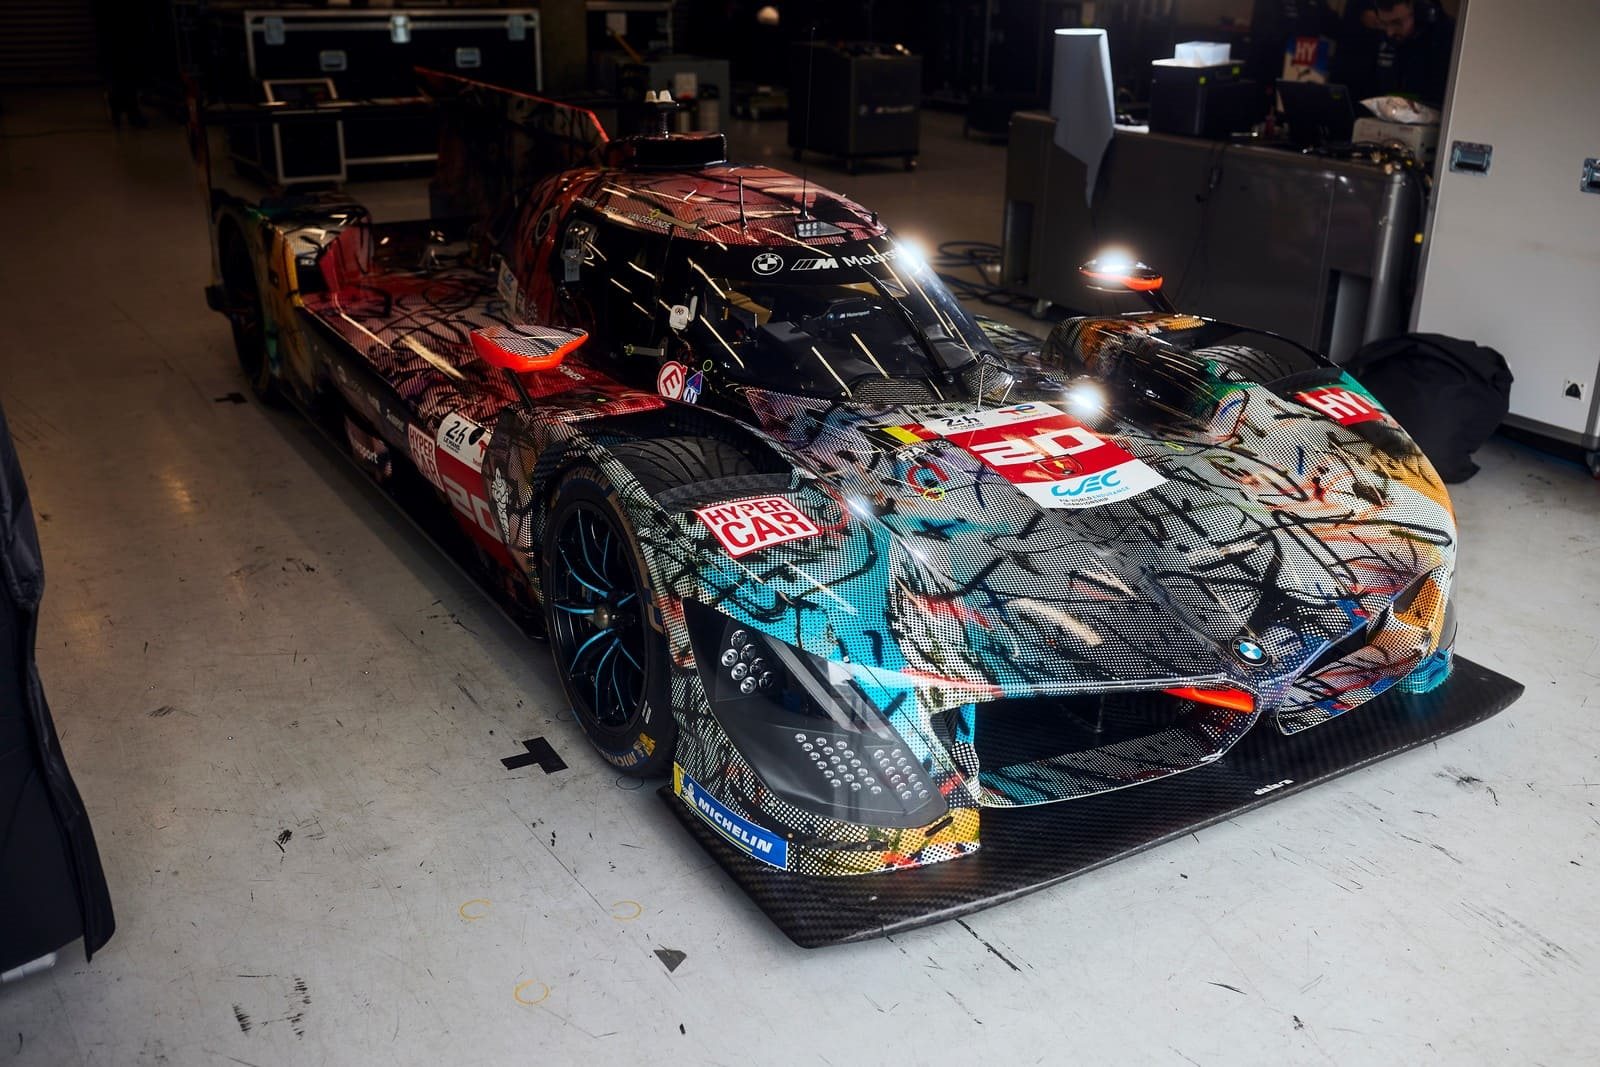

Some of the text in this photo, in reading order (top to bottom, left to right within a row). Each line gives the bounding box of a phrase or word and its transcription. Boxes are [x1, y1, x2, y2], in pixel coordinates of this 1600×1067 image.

[1305, 391, 1370, 419] HY
[408, 427, 436, 457] HYPER
[968, 426, 1106, 467] 20
[412, 446, 443, 490] CAR
[1050, 470, 1121, 496] WEC
[1063, 497, 1109, 507] CHAMPIONSHIP
[1092, 485, 1131, 500] ENDURANCE
[440, 473, 504, 544] 20
[704, 499, 790, 525] HYPER
[720, 511, 811, 548] CAR
[698, 796, 773, 854] MICHELIN
